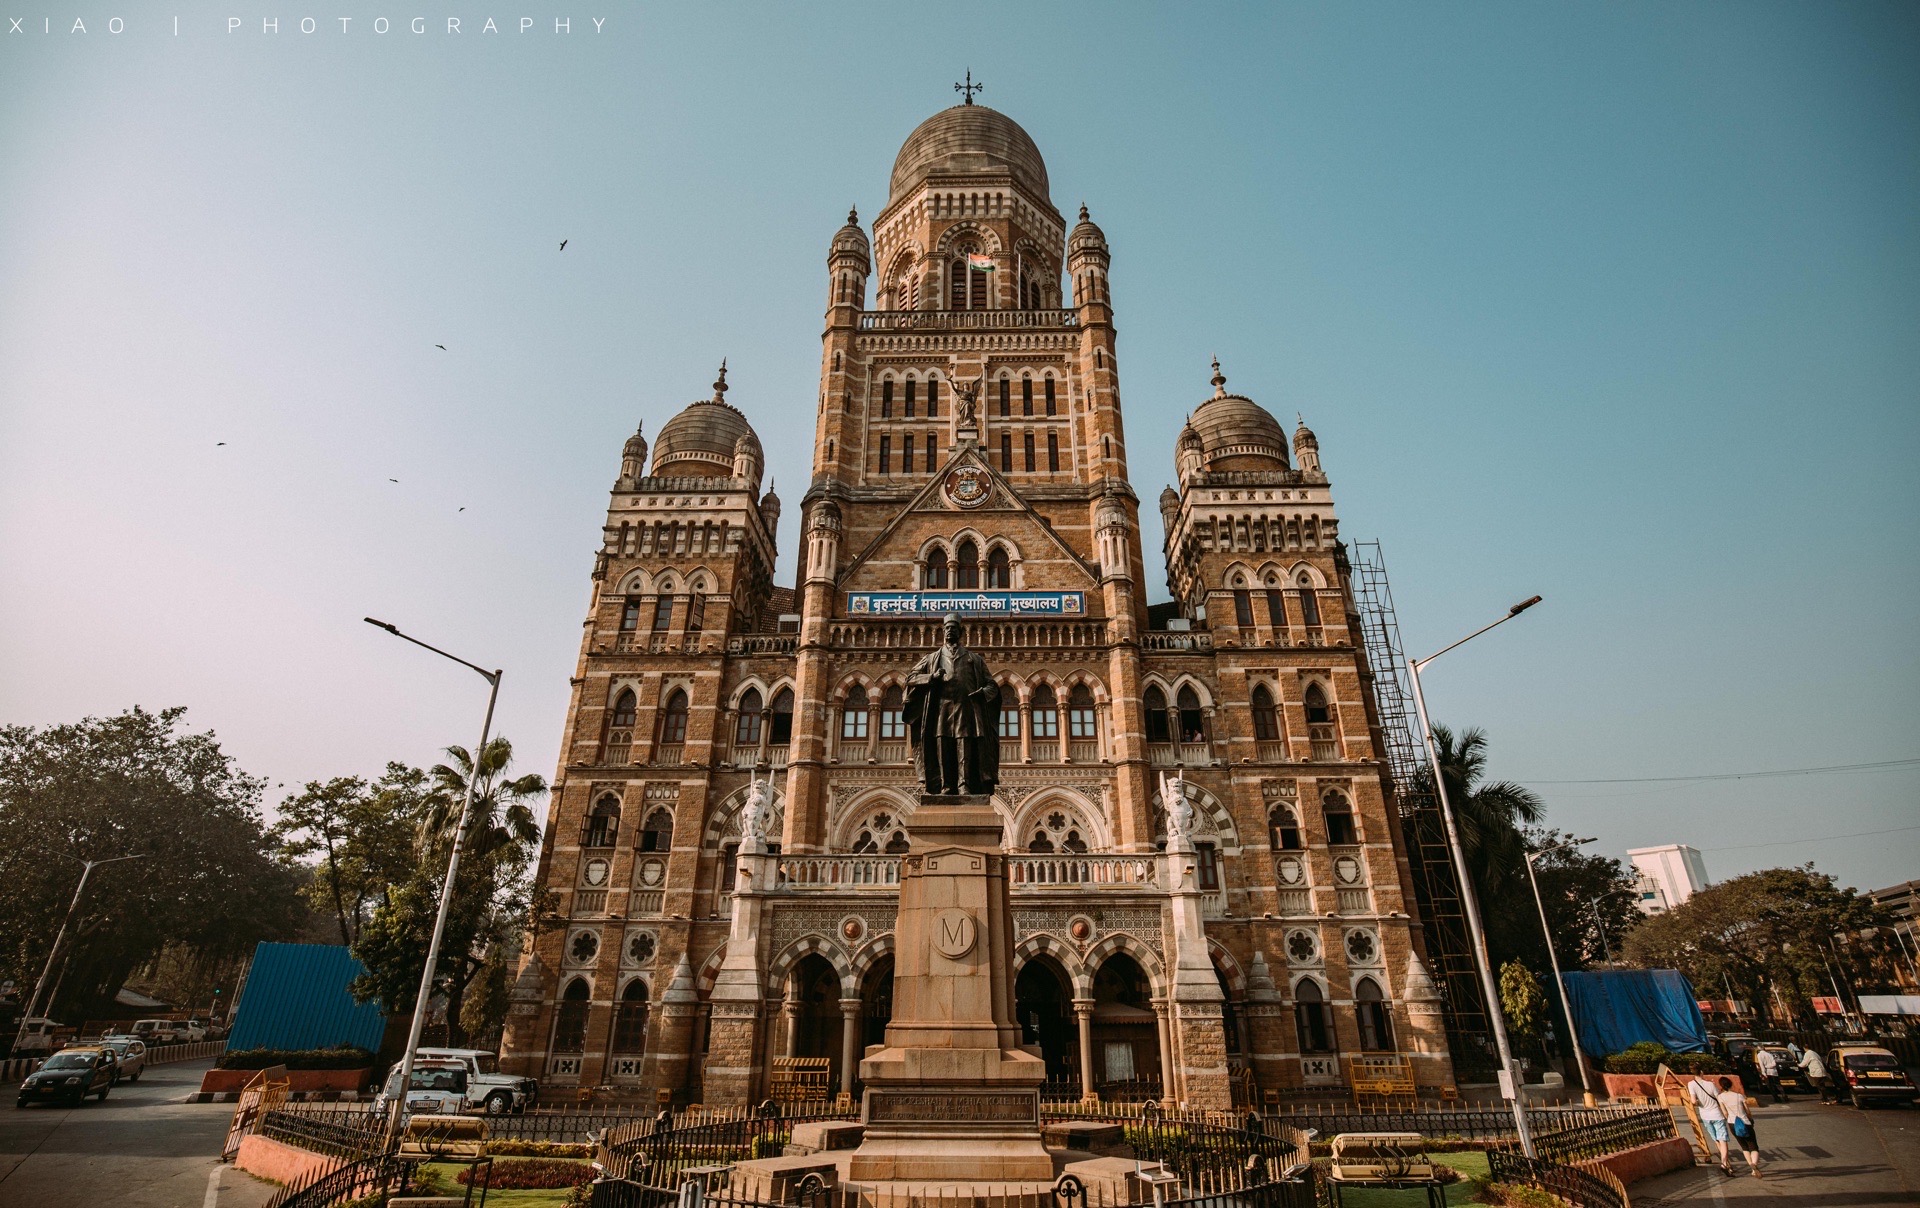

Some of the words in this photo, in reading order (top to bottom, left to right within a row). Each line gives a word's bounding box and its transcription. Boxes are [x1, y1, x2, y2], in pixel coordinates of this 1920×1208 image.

[921, 594, 1007, 611] महानगरपालिका
[1010, 597, 1060, 614] मुख्यालय
[941, 917, 965, 948] M
